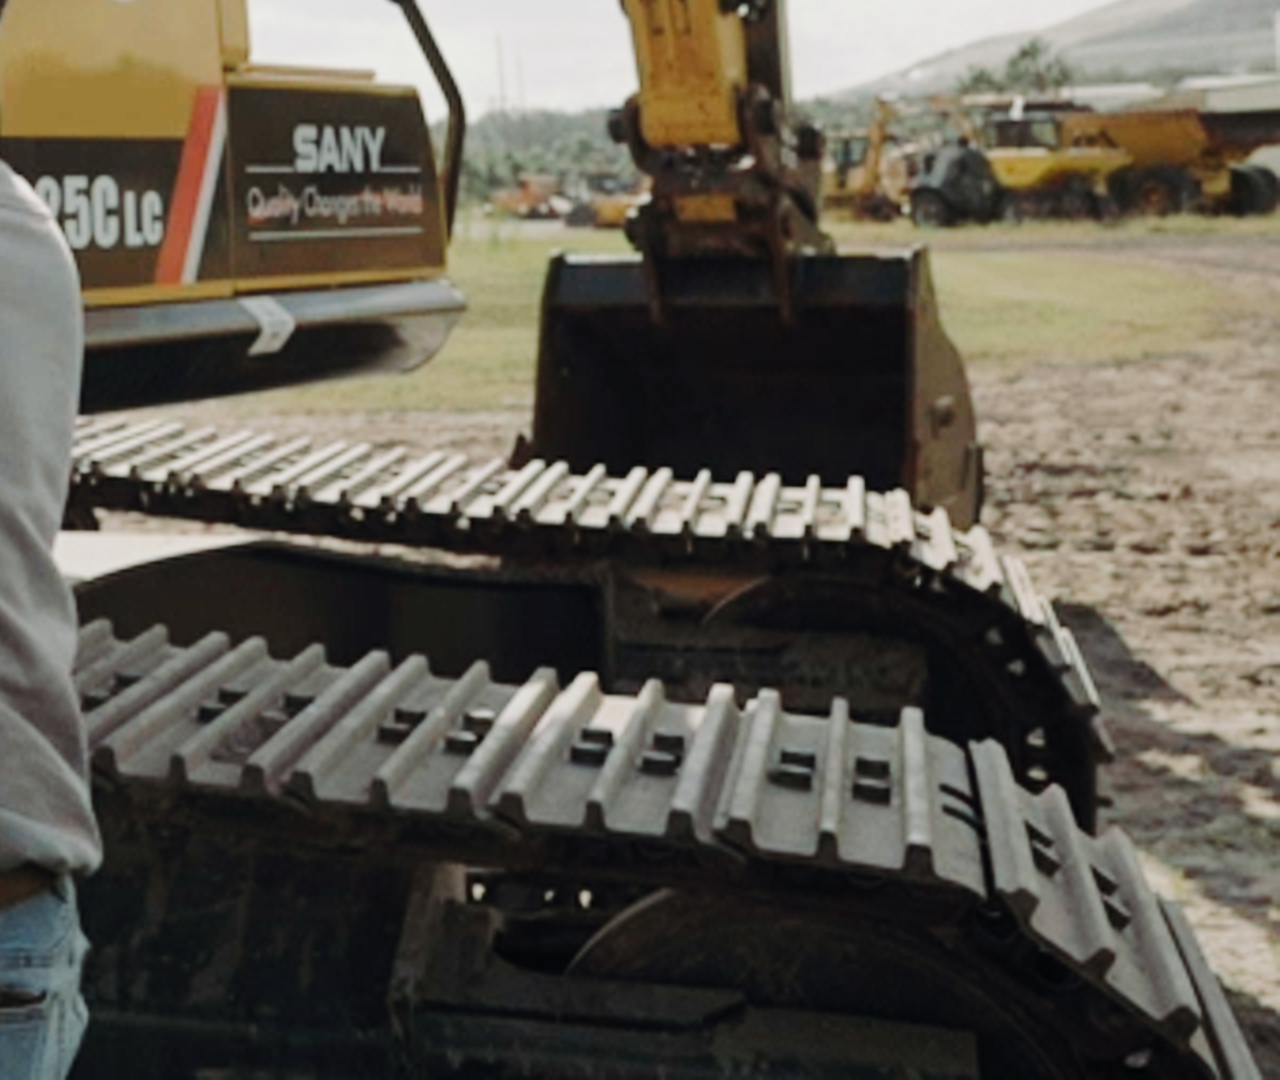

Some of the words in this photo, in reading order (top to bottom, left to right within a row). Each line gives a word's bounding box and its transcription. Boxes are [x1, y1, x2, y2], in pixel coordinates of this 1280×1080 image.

[293, 124, 385, 173] SANY
[123, 190, 164, 248] LC
[247, 183, 299, 224] Quality
